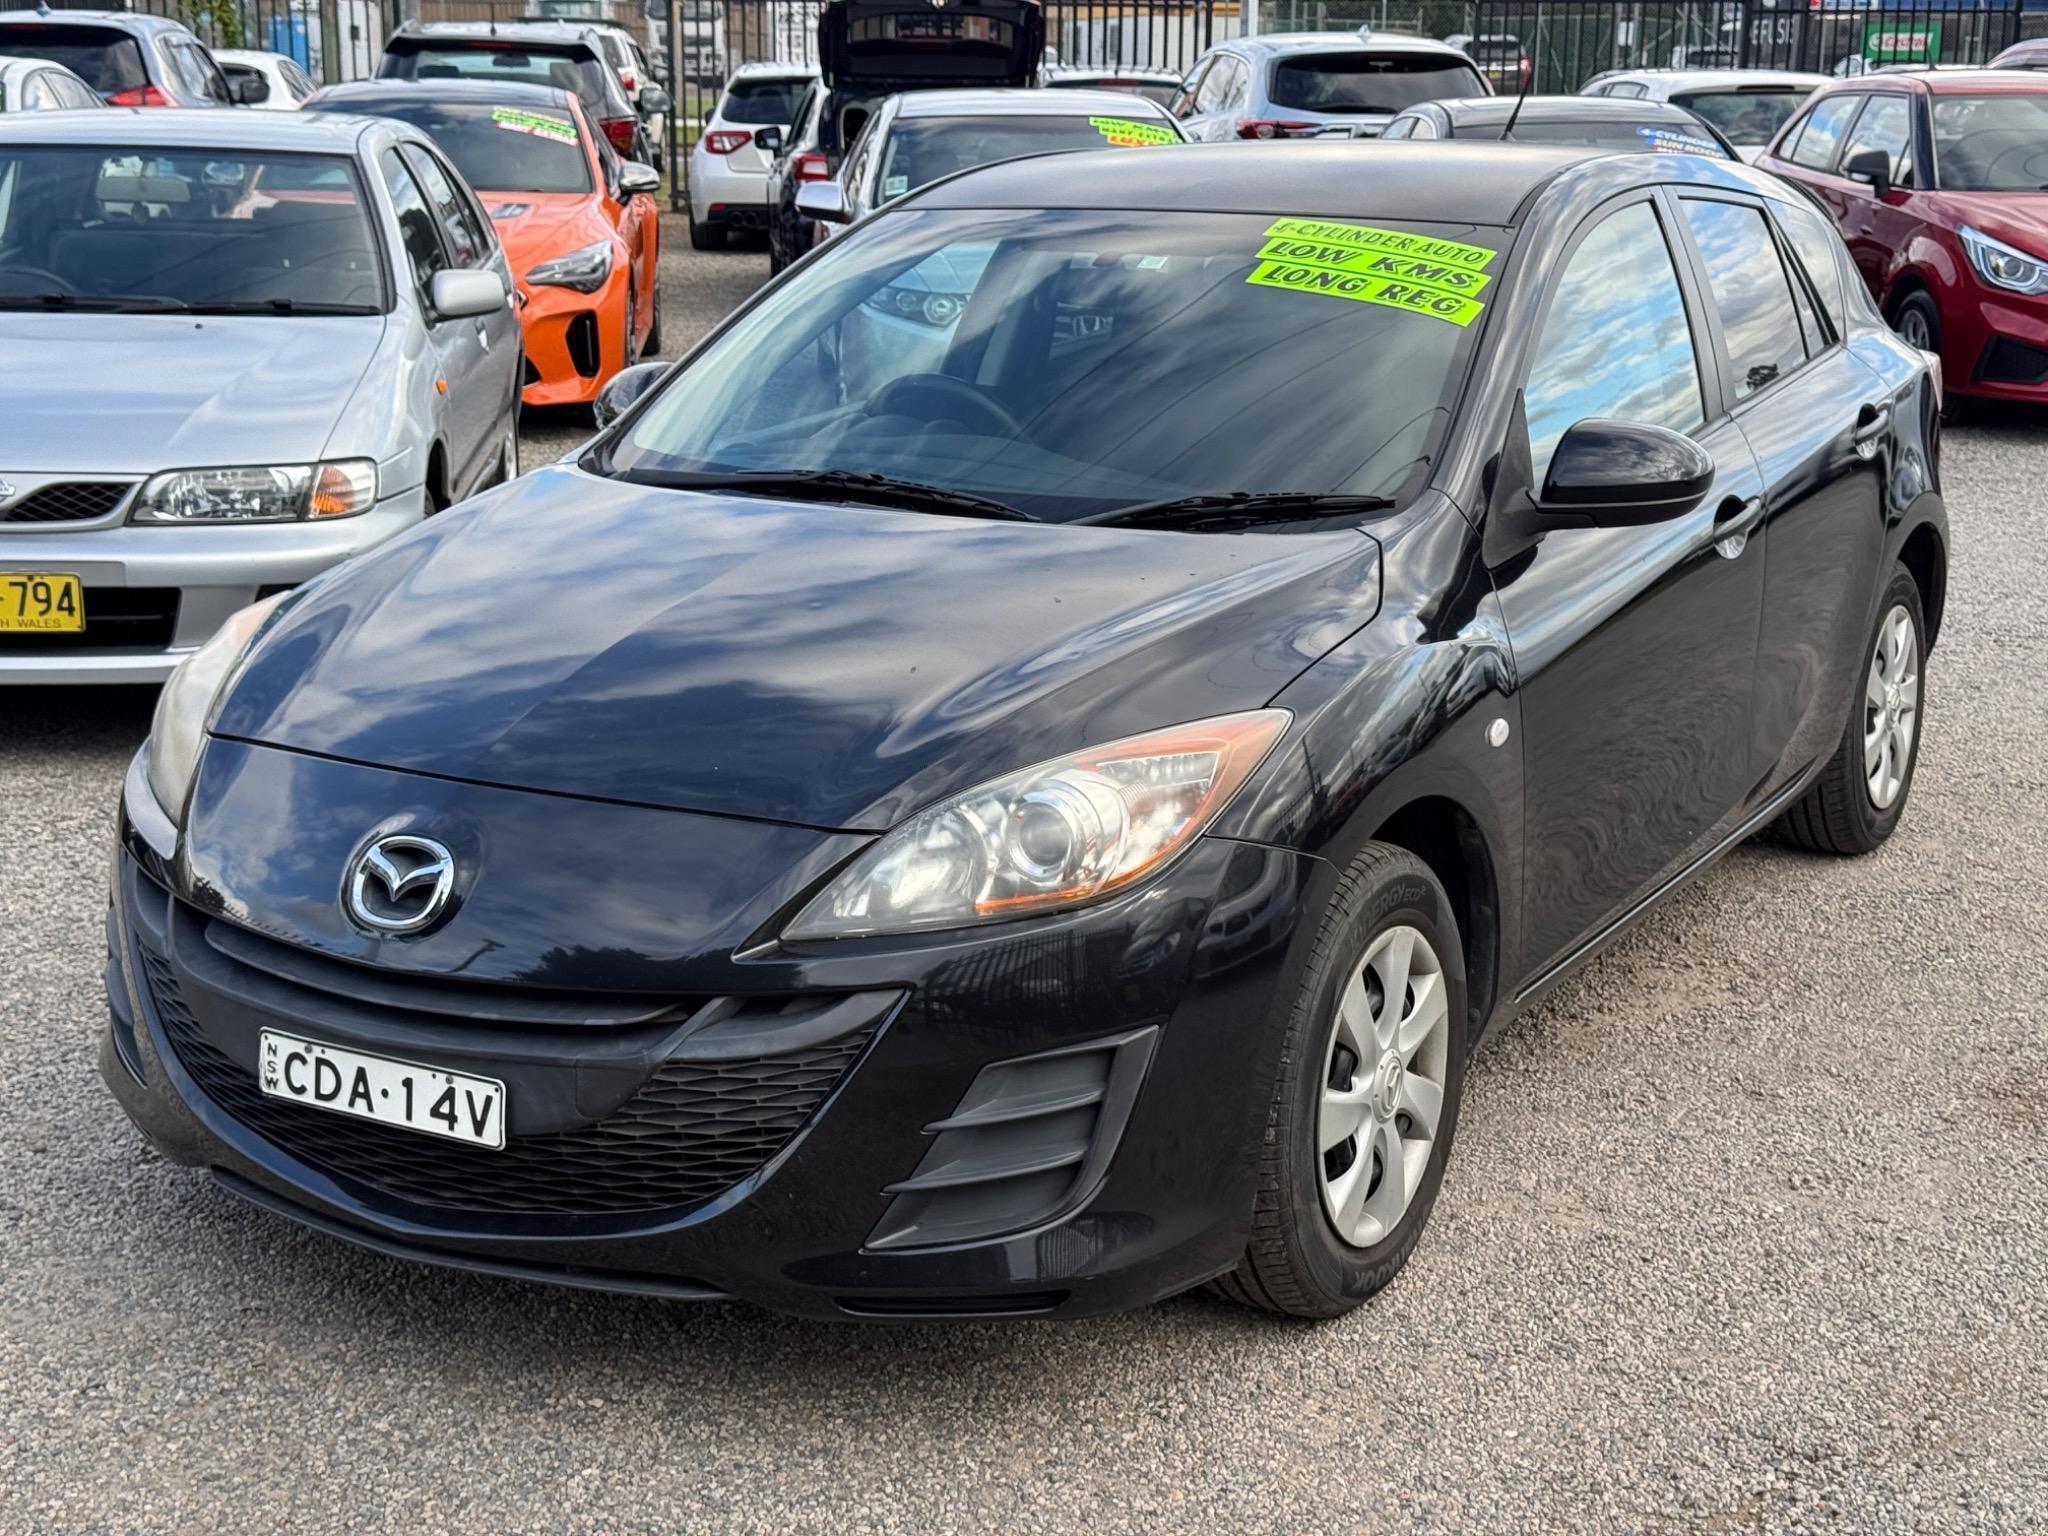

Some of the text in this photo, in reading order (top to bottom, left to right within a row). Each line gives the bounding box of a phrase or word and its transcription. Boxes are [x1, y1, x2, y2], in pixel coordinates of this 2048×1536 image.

[1265, 240, 1480, 289] LOW KMS
[1417, 241, 1487, 264] AUTO
[1262, 264, 1467, 315] LONG REG
[17, 618, 62, 629] WALES
